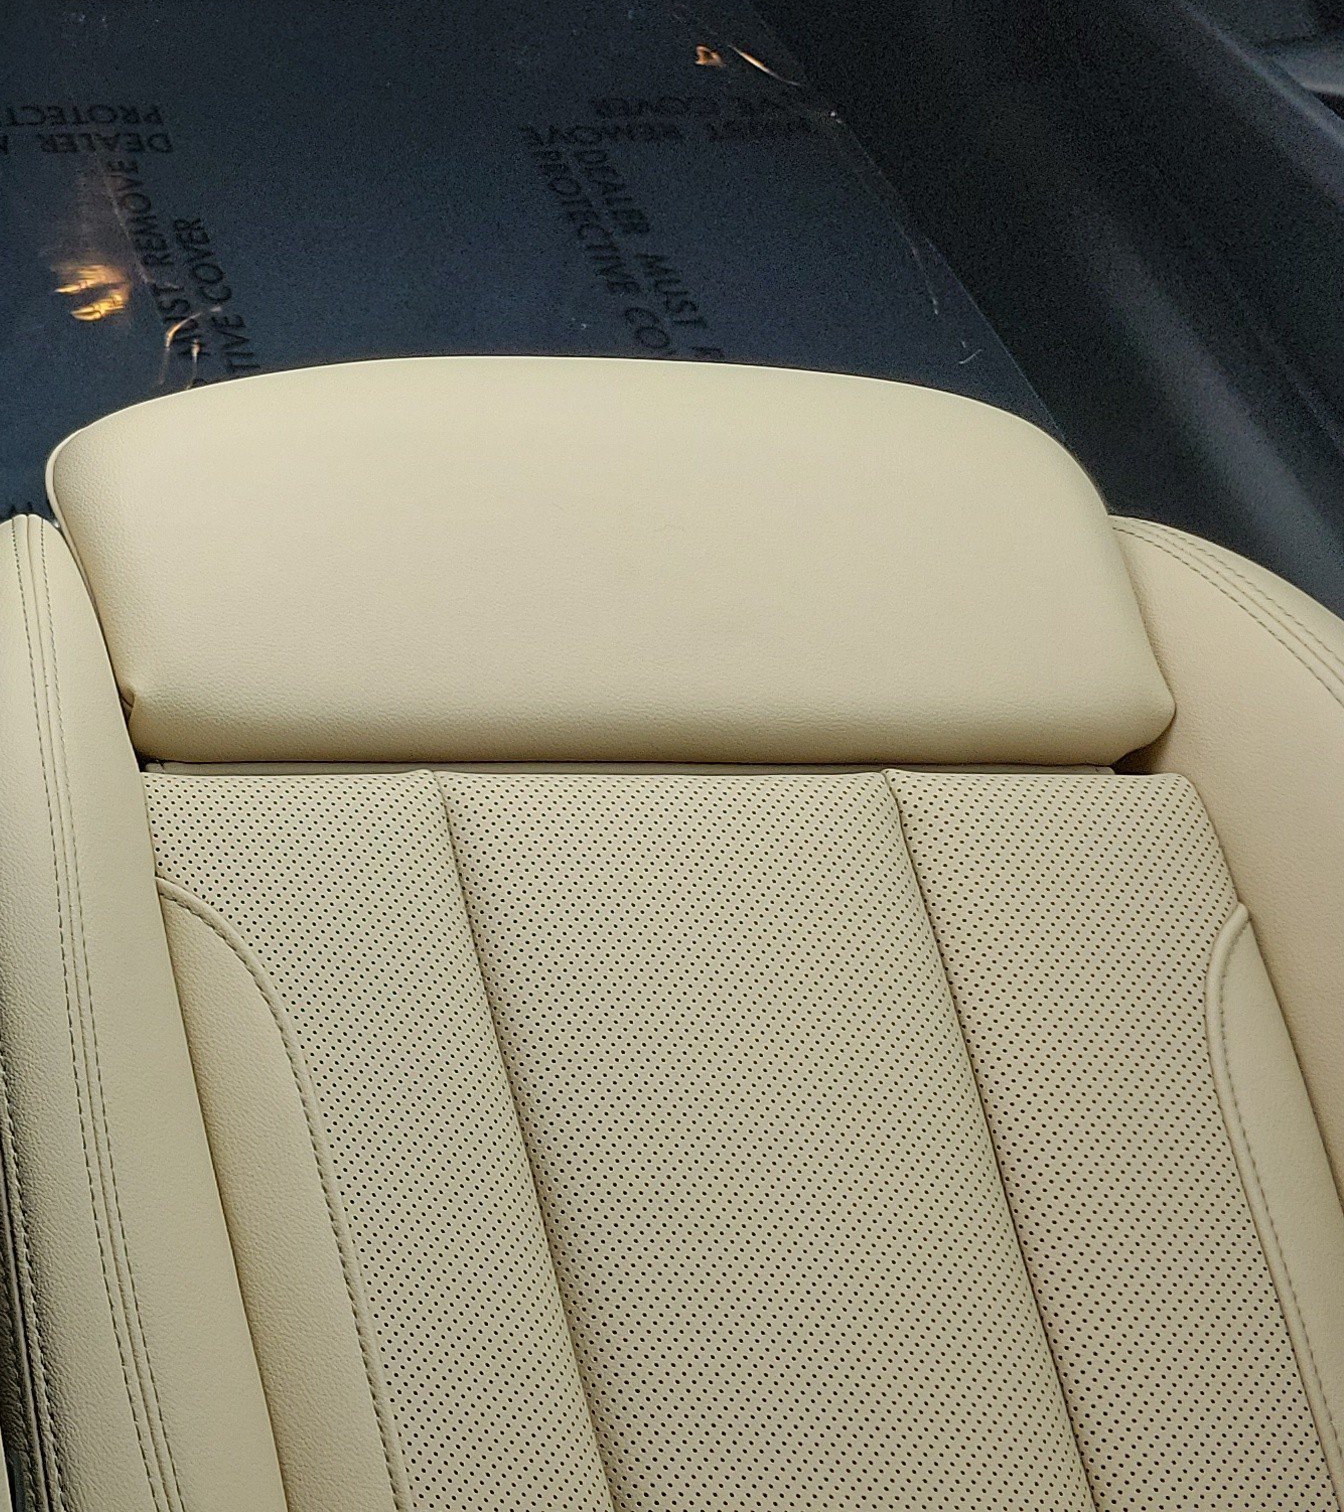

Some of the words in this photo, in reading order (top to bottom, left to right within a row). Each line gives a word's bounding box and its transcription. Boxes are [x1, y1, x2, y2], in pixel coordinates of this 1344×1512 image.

[38, 132, 173, 154] DEALER
[107, 158, 173, 268] REMOVE
[173, 217, 232, 303] COVER
